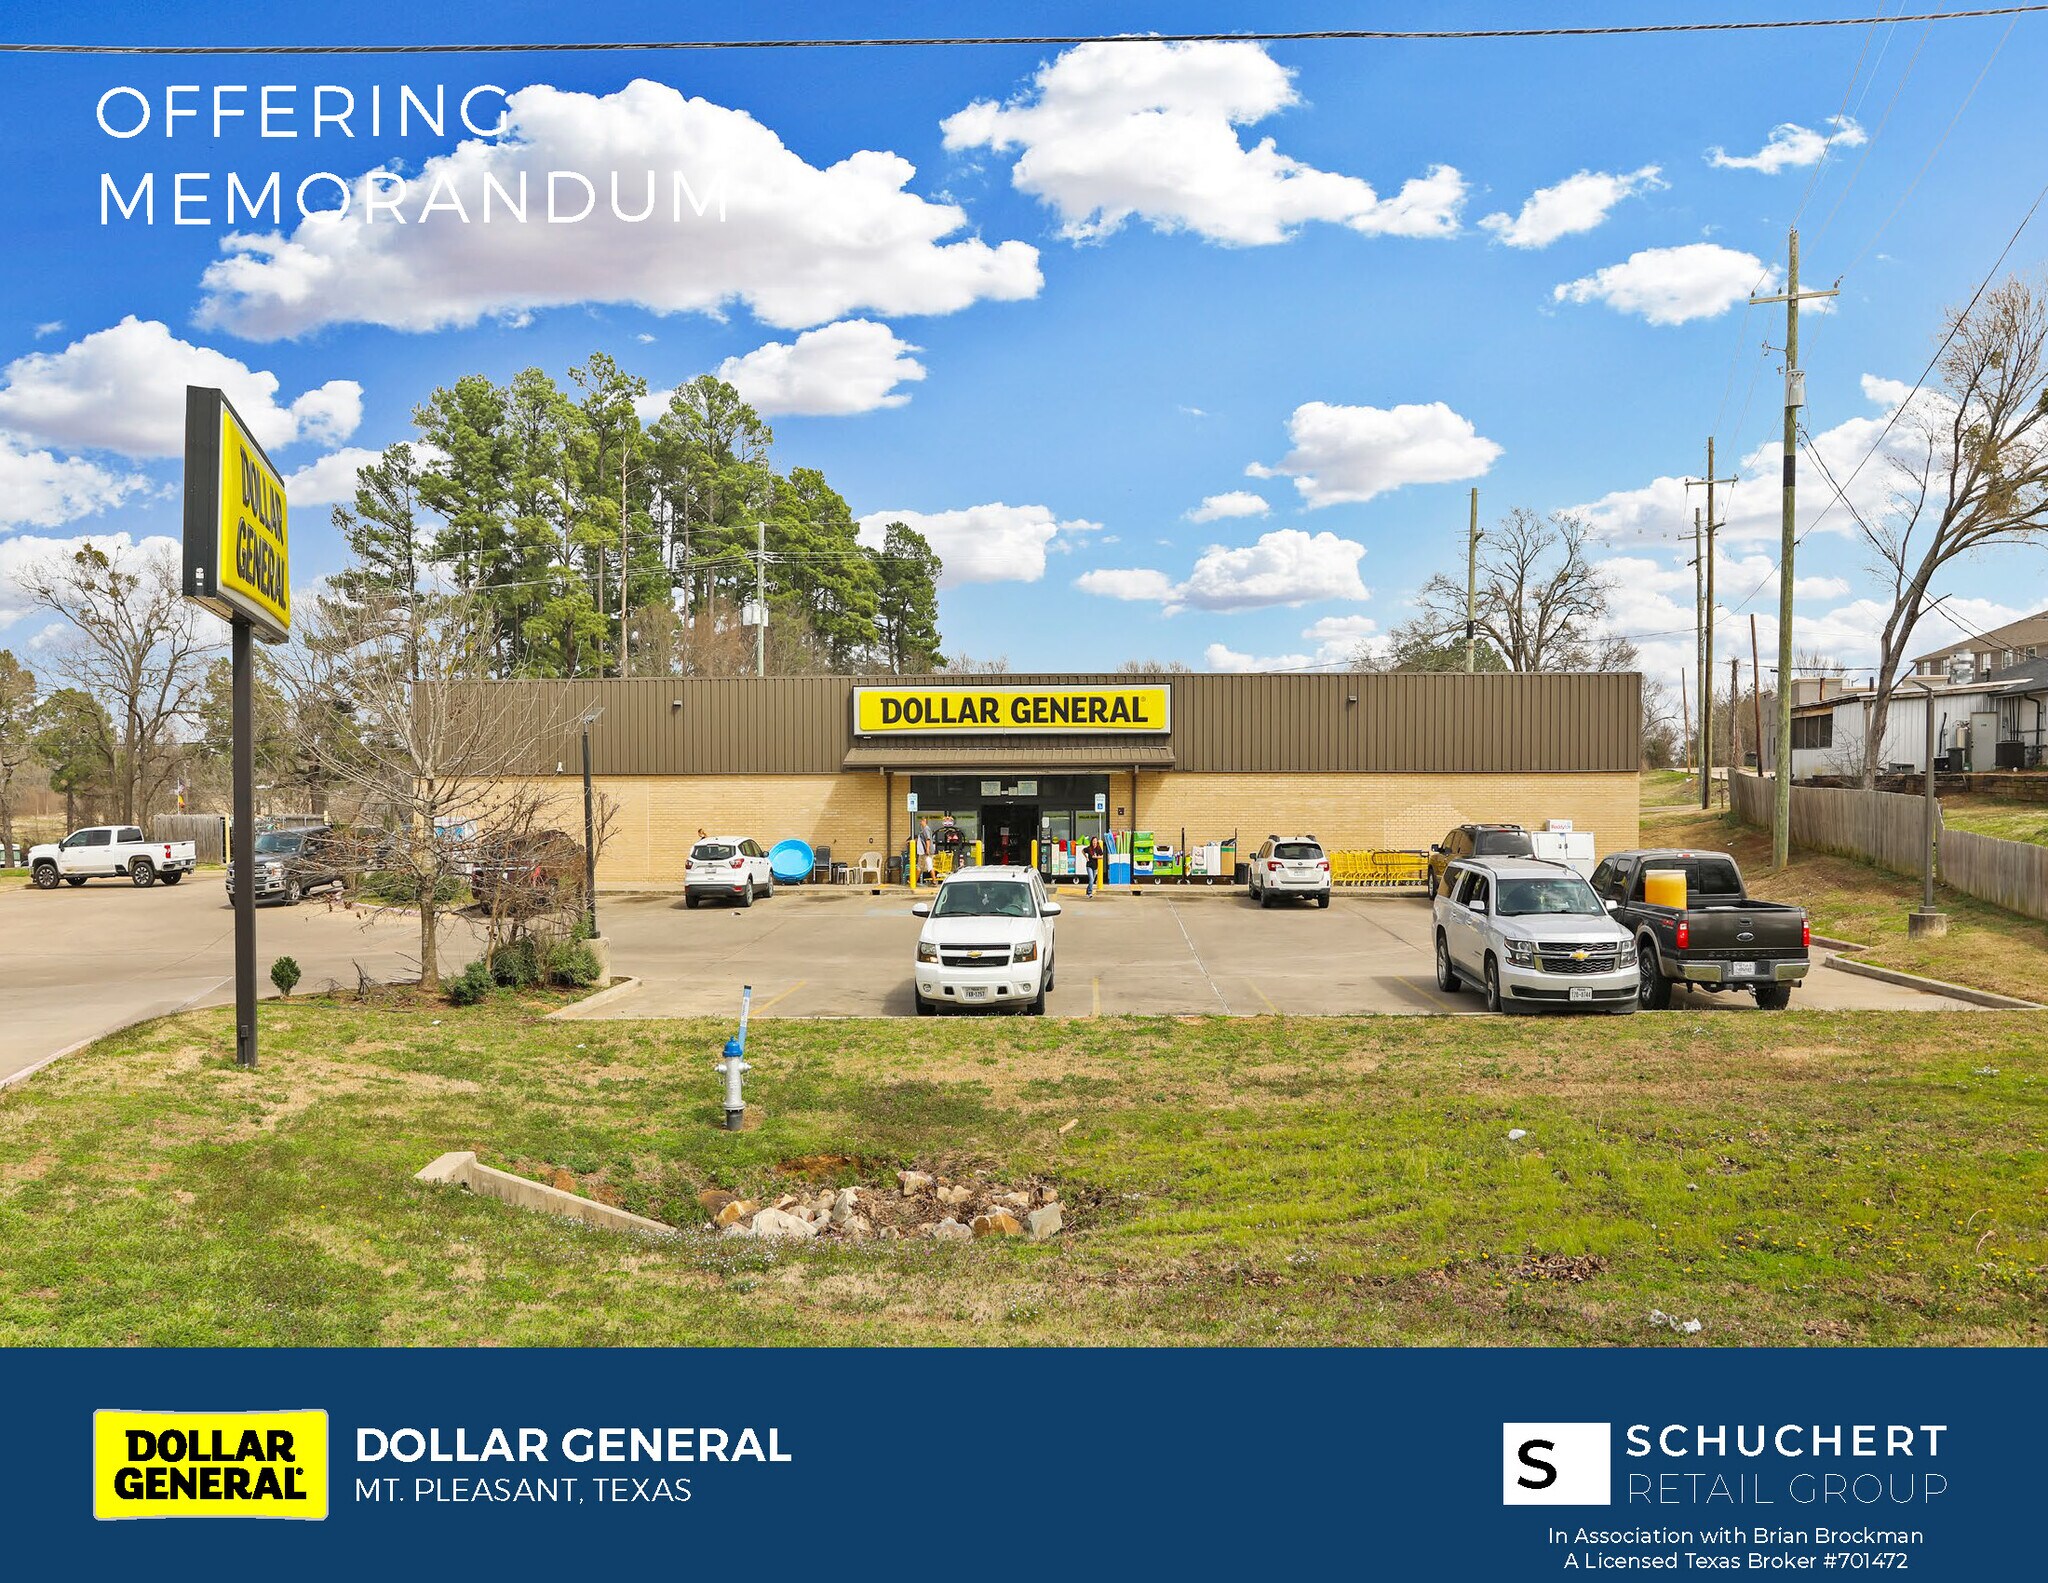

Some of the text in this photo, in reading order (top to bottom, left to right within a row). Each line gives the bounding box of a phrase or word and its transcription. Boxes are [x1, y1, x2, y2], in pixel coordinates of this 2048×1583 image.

[240, 446, 283, 545] DOLLAR
[236, 517, 286, 610] GENERAL
[880, 696, 1149, 724] DOLLAR GENERAL
